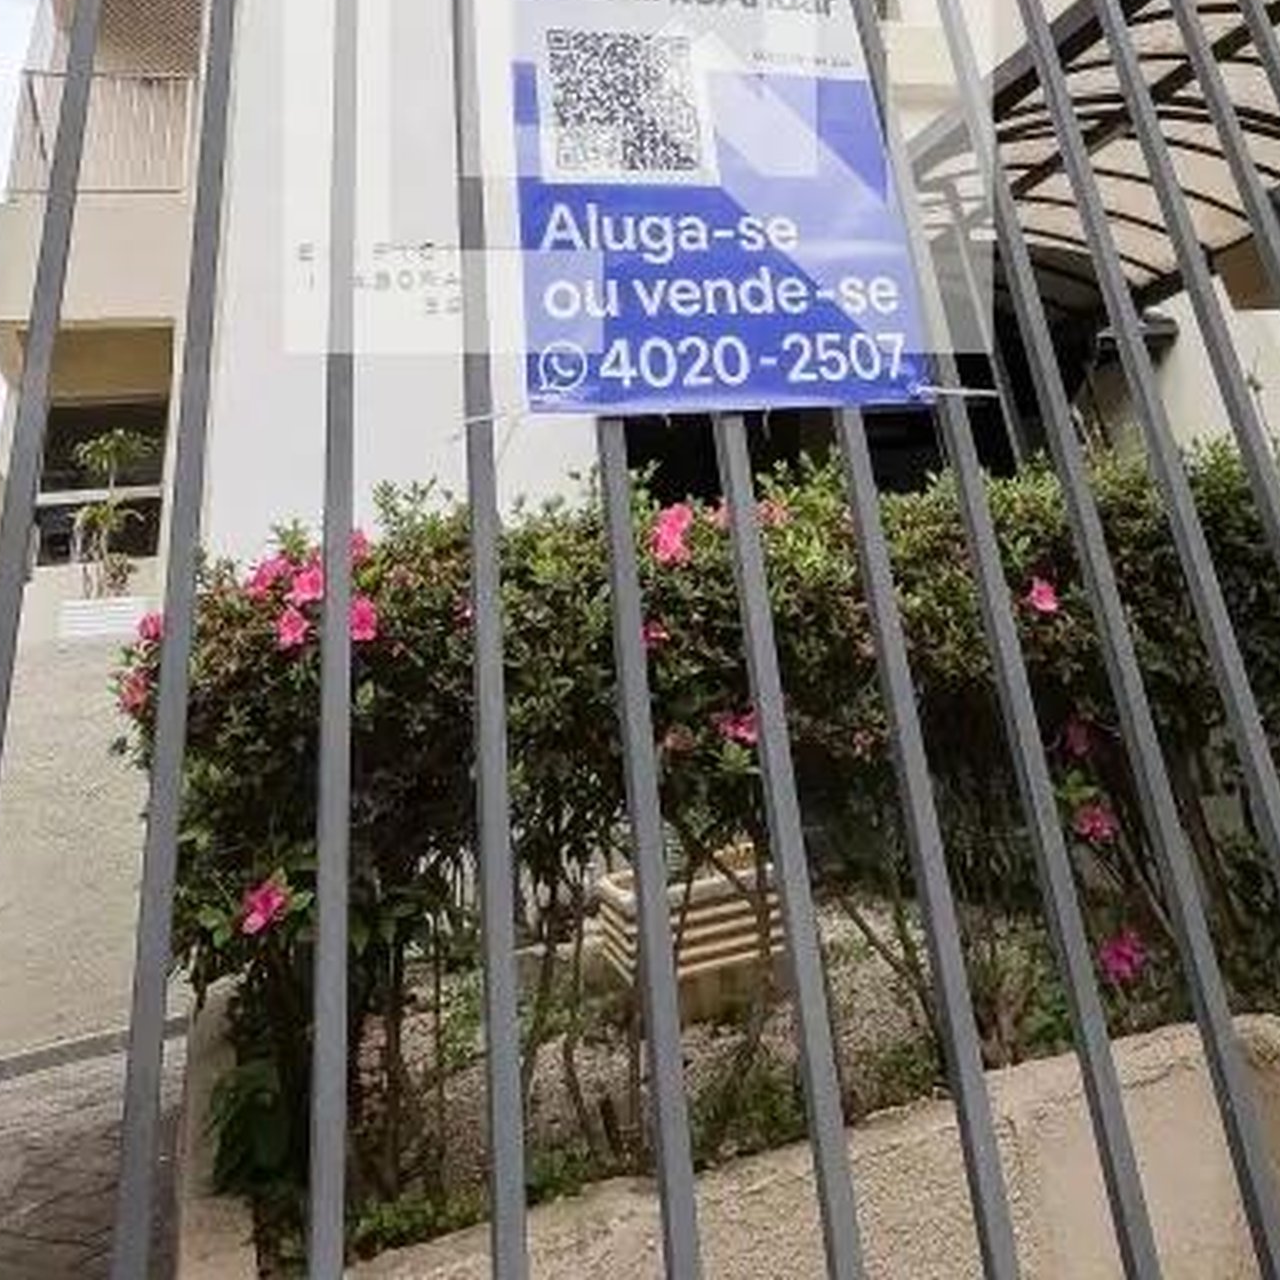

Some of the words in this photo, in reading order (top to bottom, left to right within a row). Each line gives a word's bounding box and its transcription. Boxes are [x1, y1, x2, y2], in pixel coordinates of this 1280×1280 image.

[540, 203, 800, 264] Aluga-se
[542, 277, 618, 319] ou
[633, 266, 900, 317] vende-se
